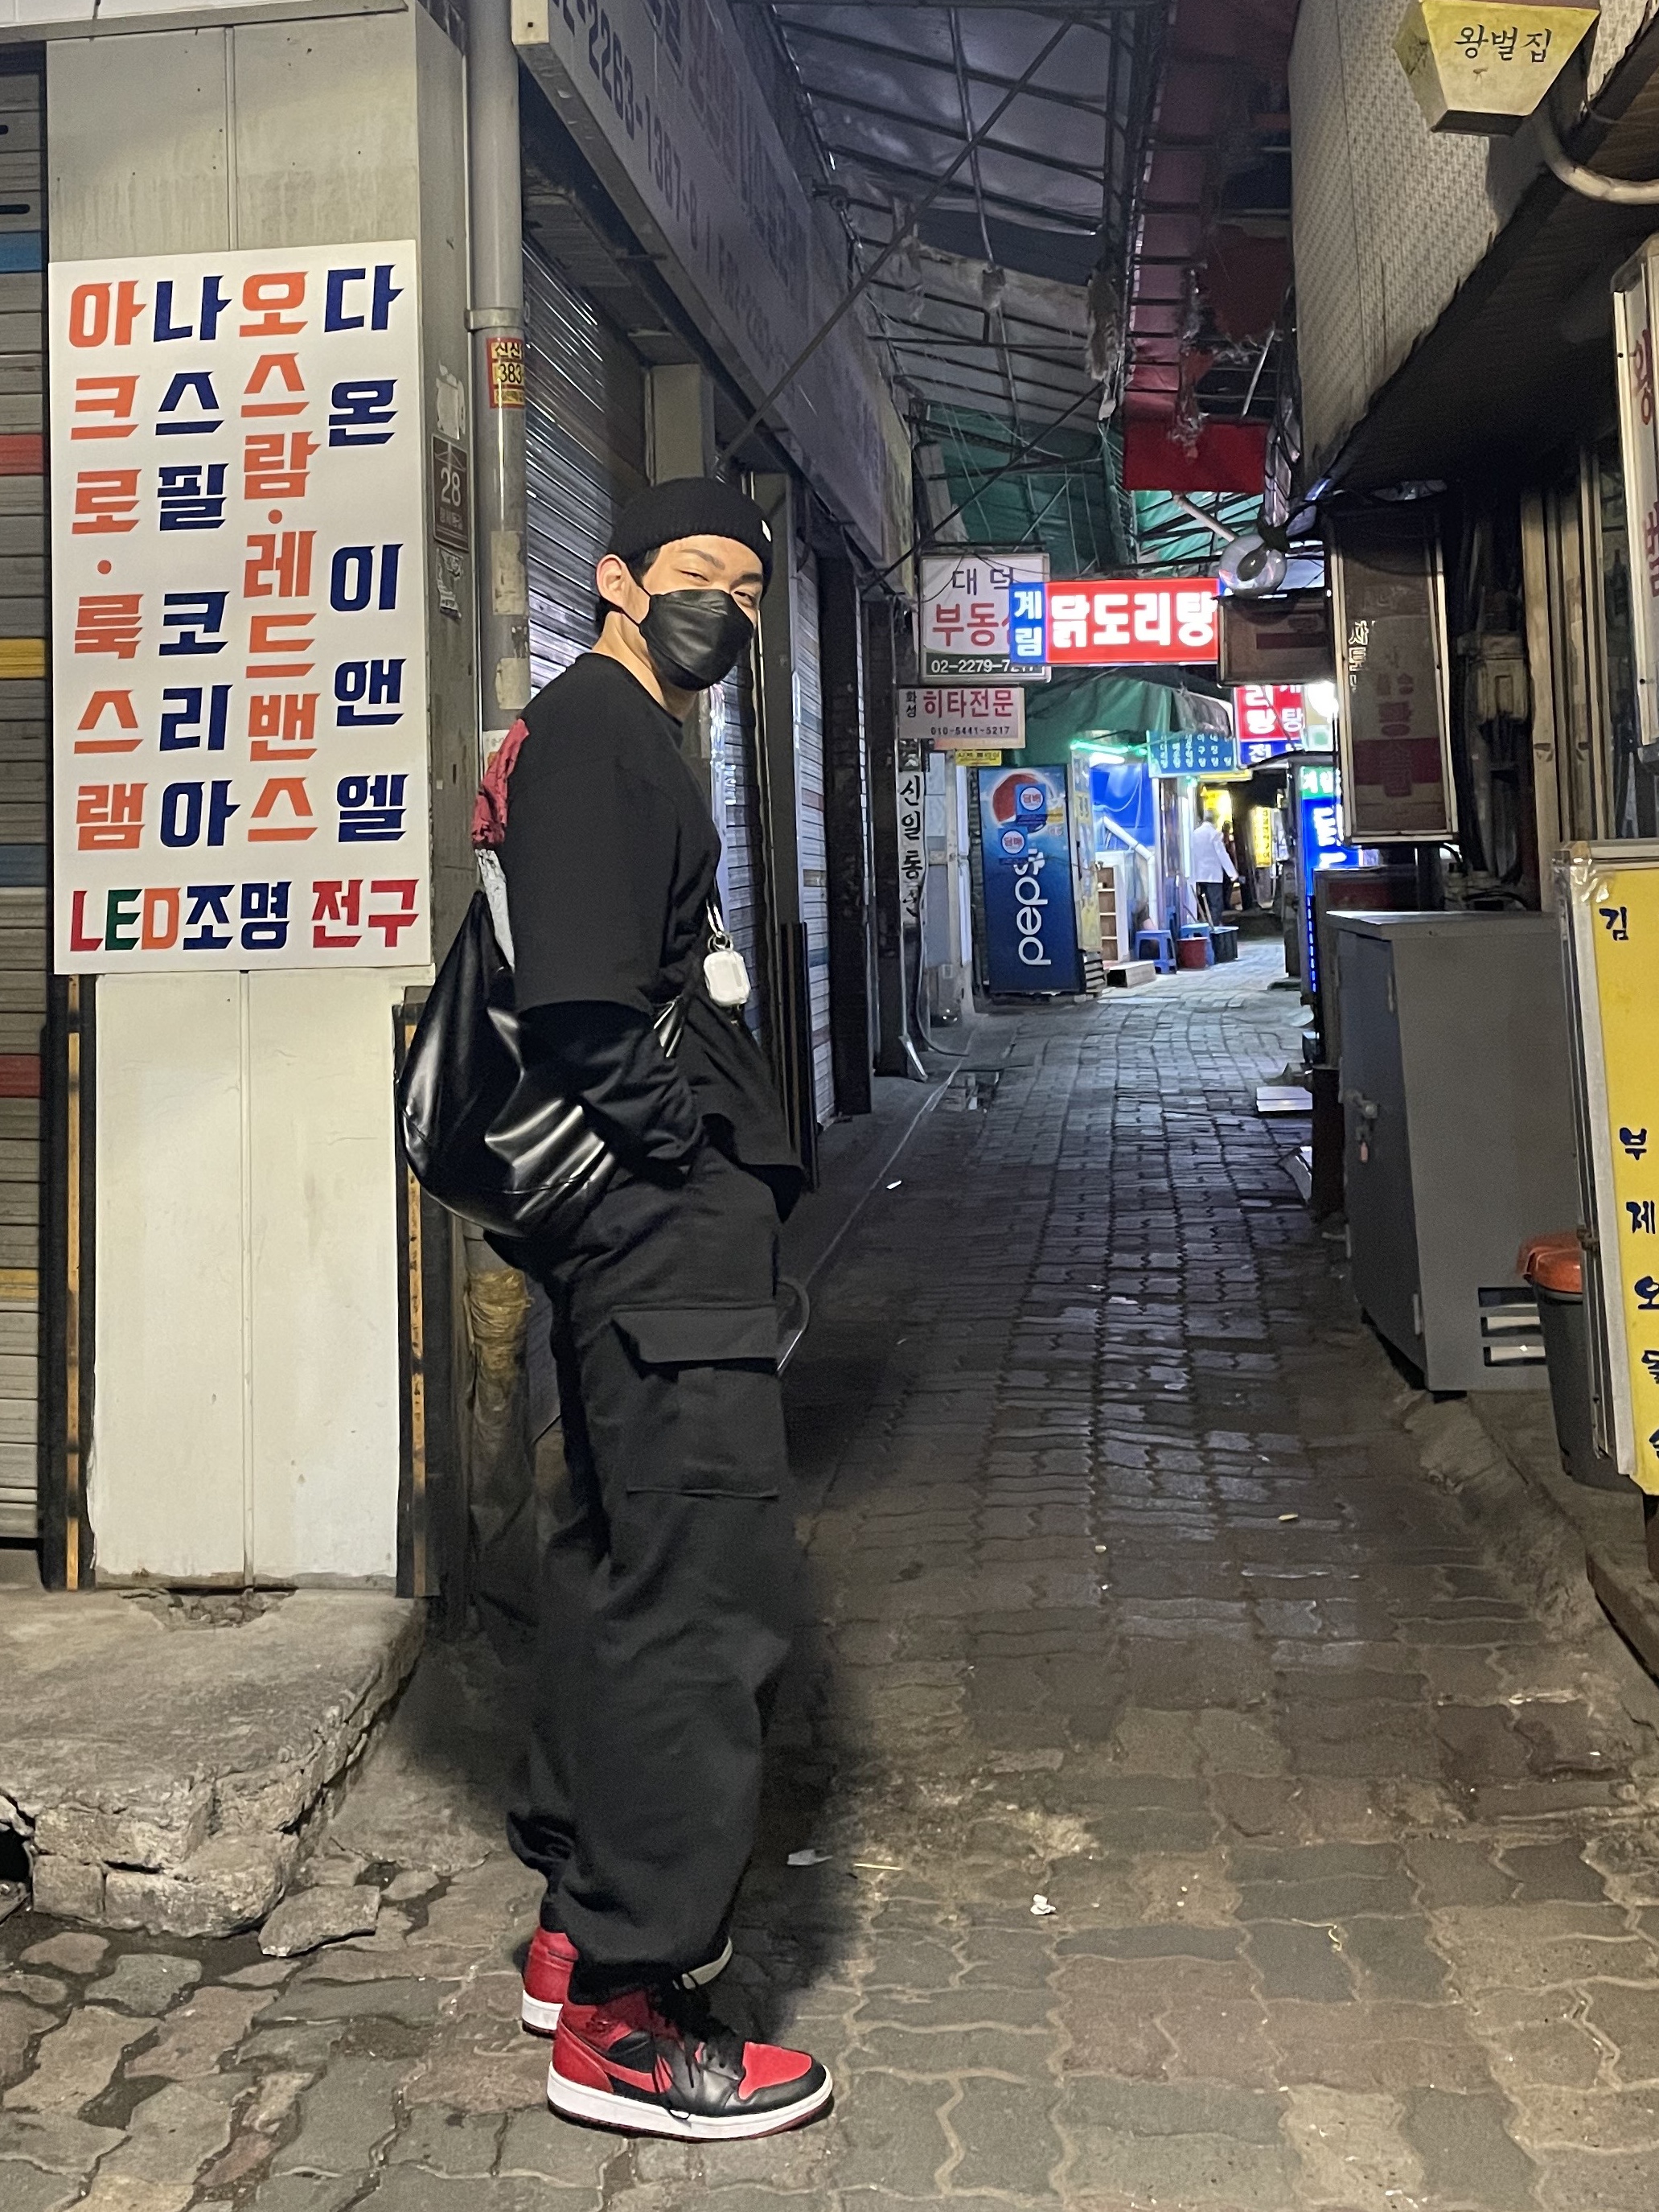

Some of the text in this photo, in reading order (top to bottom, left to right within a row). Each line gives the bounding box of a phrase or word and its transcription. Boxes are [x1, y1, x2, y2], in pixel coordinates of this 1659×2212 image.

[1454, 23, 1552, 63] 왕벌집
[441, 467, 461, 507] 28
[154, 275, 240, 848] 나스필 코리아
[324, 264, 409, 843] 다온 이앤엘
[932, 602, 1010, 647] 부동
[1014, 590, 1042, 657] 계림
[1051, 591, 1218, 648] 닭도리탕
[931, 659, 1033, 673] 02-2279-7
[905, 690, 917, 718] 화성
[70, 878, 419, 952] LED조명 전구
[1599, 906, 1629, 941] 김
[1619, 1127, 1648, 1161] 부
